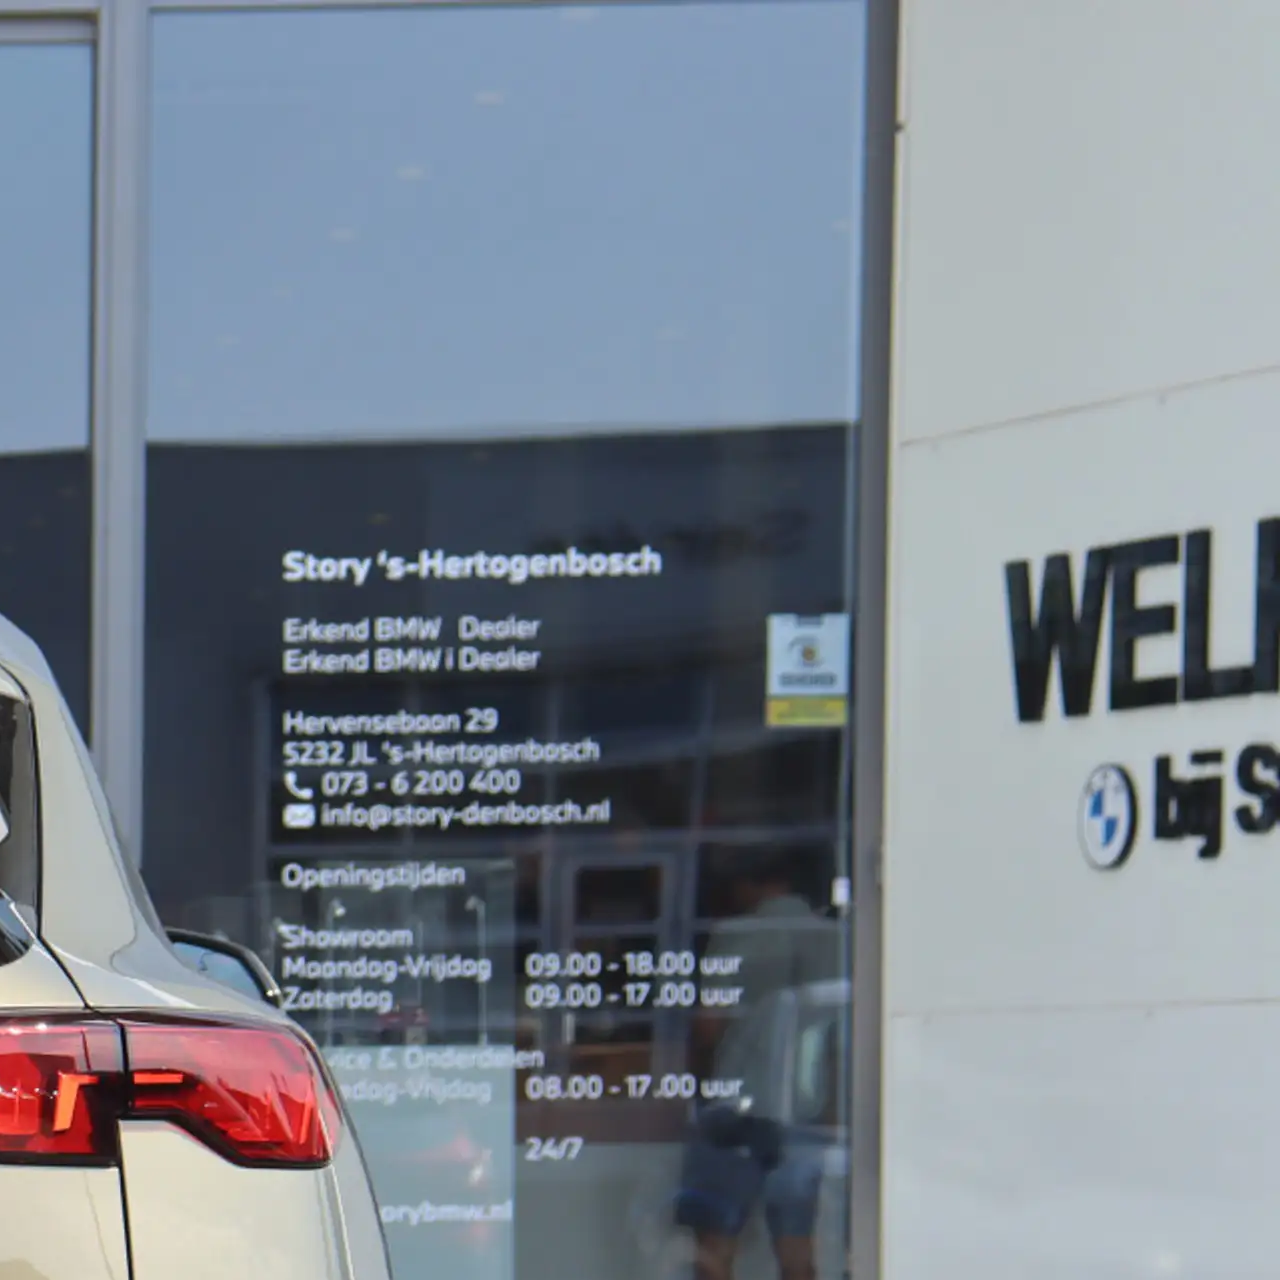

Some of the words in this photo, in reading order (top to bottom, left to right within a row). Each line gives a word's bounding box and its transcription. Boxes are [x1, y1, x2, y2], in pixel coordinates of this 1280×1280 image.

[282, 550, 372, 586] Story
[283, 617, 370, 643] Erkend
[374, 616, 442, 642] BMW
[458, 615, 540, 641] Dealer
[283, 648, 370, 674] Erkend
[374, 647, 442, 673] BMW
[444, 647, 454, 670] i
[458, 646, 541, 671] Dealer
[282, 709, 461, 735] Hervensebaan
[464, 707, 499, 733] 29
[283, 740, 345, 766] 5232
[348, 741, 377, 767] JL
[321, 770, 368, 796] 073
[391, 770, 410, 795] 6
[413, 769, 465, 795] 200
[469, 771, 520, 794] 400
[321, 799, 611, 831] info@story-denbosch.nl
[1153, 750, 1224, 859] bij
[282, 861, 466, 892] Openingstijden
[283, 925, 412, 948] Showroom
[282, 957, 491, 983] Maandag-Vrijdag
[525, 952, 602, 978] 09.00
[624, 950, 695, 976] 18.00
[700, 955, 743, 976] uur
[281, 987, 393, 1011] Zaterdag
[525, 983, 602, 1009] 09.00
[624, 981, 696, 1007] 17.00
[700, 987, 743, 1006] uur
[377, 1047, 395, 1069] &
[404, 1046, 544, 1069] Onderdelen
[525, 1075, 603, 1100] 08.00
[625, 1073, 696, 1099] 17.00
[701, 1079, 741, 1098] uur
[523, 1136, 583, 1162] 24/7
